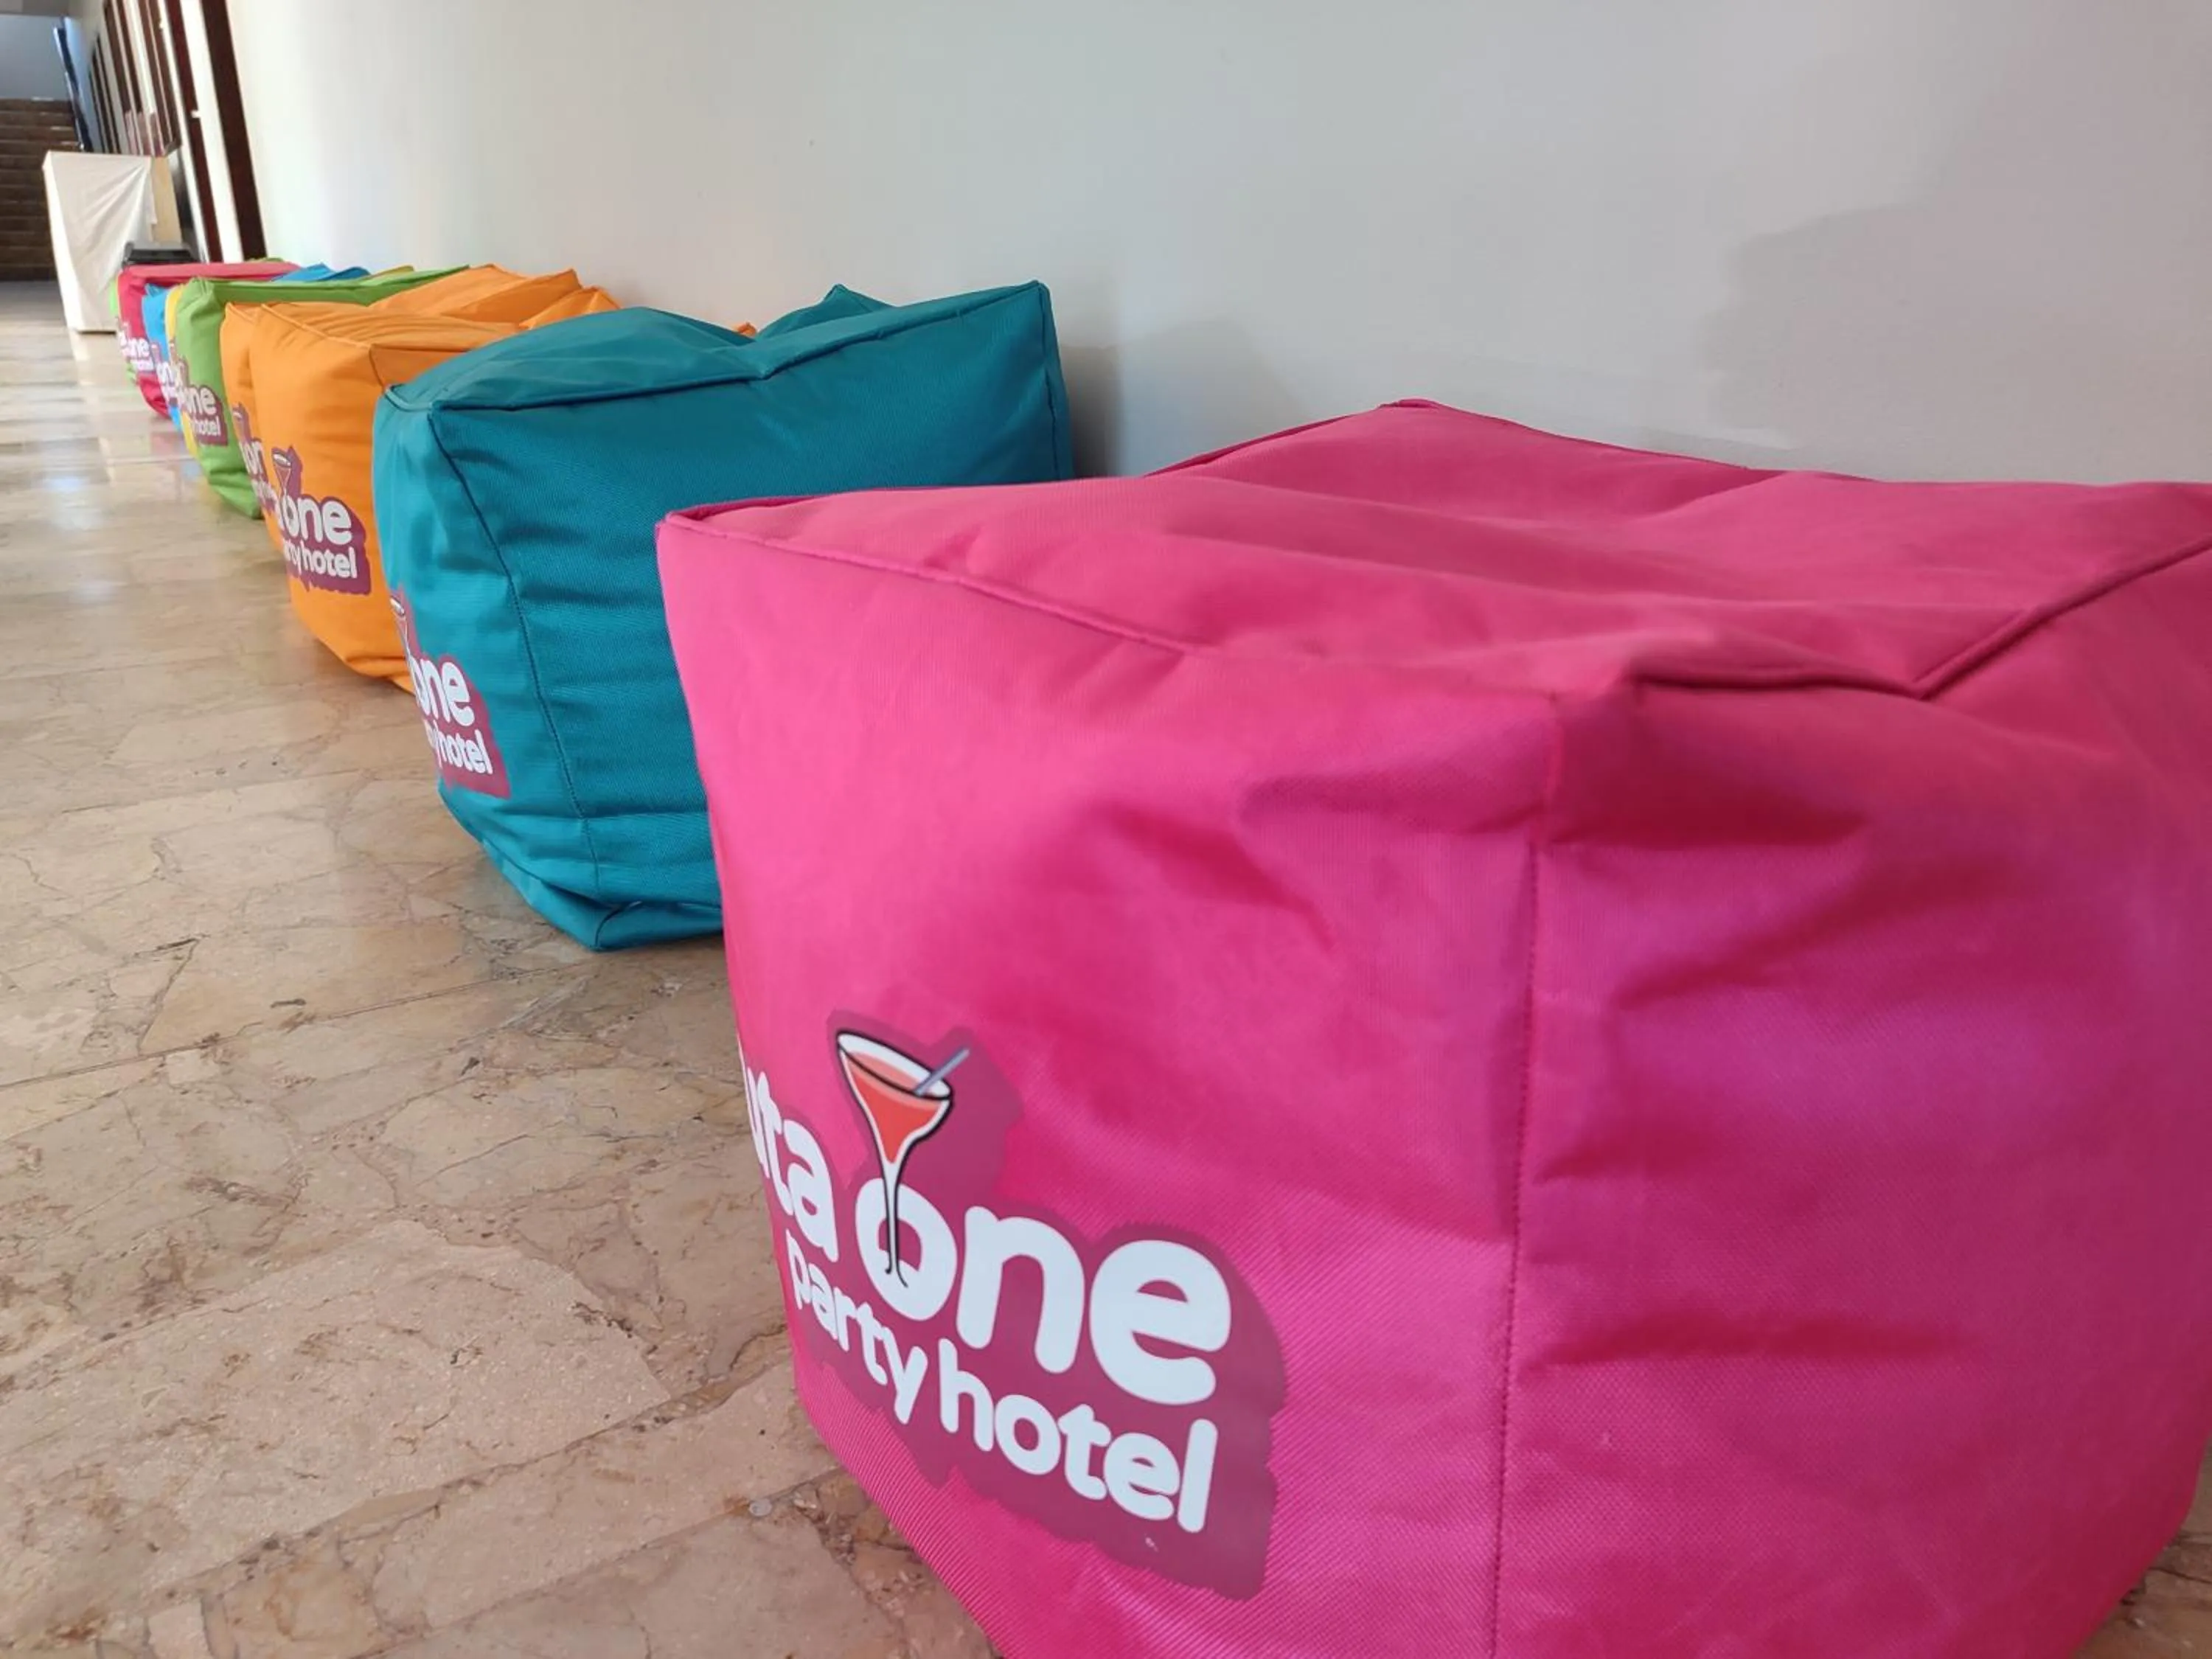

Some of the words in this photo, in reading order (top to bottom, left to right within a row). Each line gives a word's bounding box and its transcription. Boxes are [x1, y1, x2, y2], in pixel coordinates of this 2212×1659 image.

[282, 495, 353, 545] one
[300, 539, 358, 579] hotel
[855, 1178, 1231, 1405] one
[786, 1229, 928, 1425] party
[939, 1338, 1219, 1533] hotel
